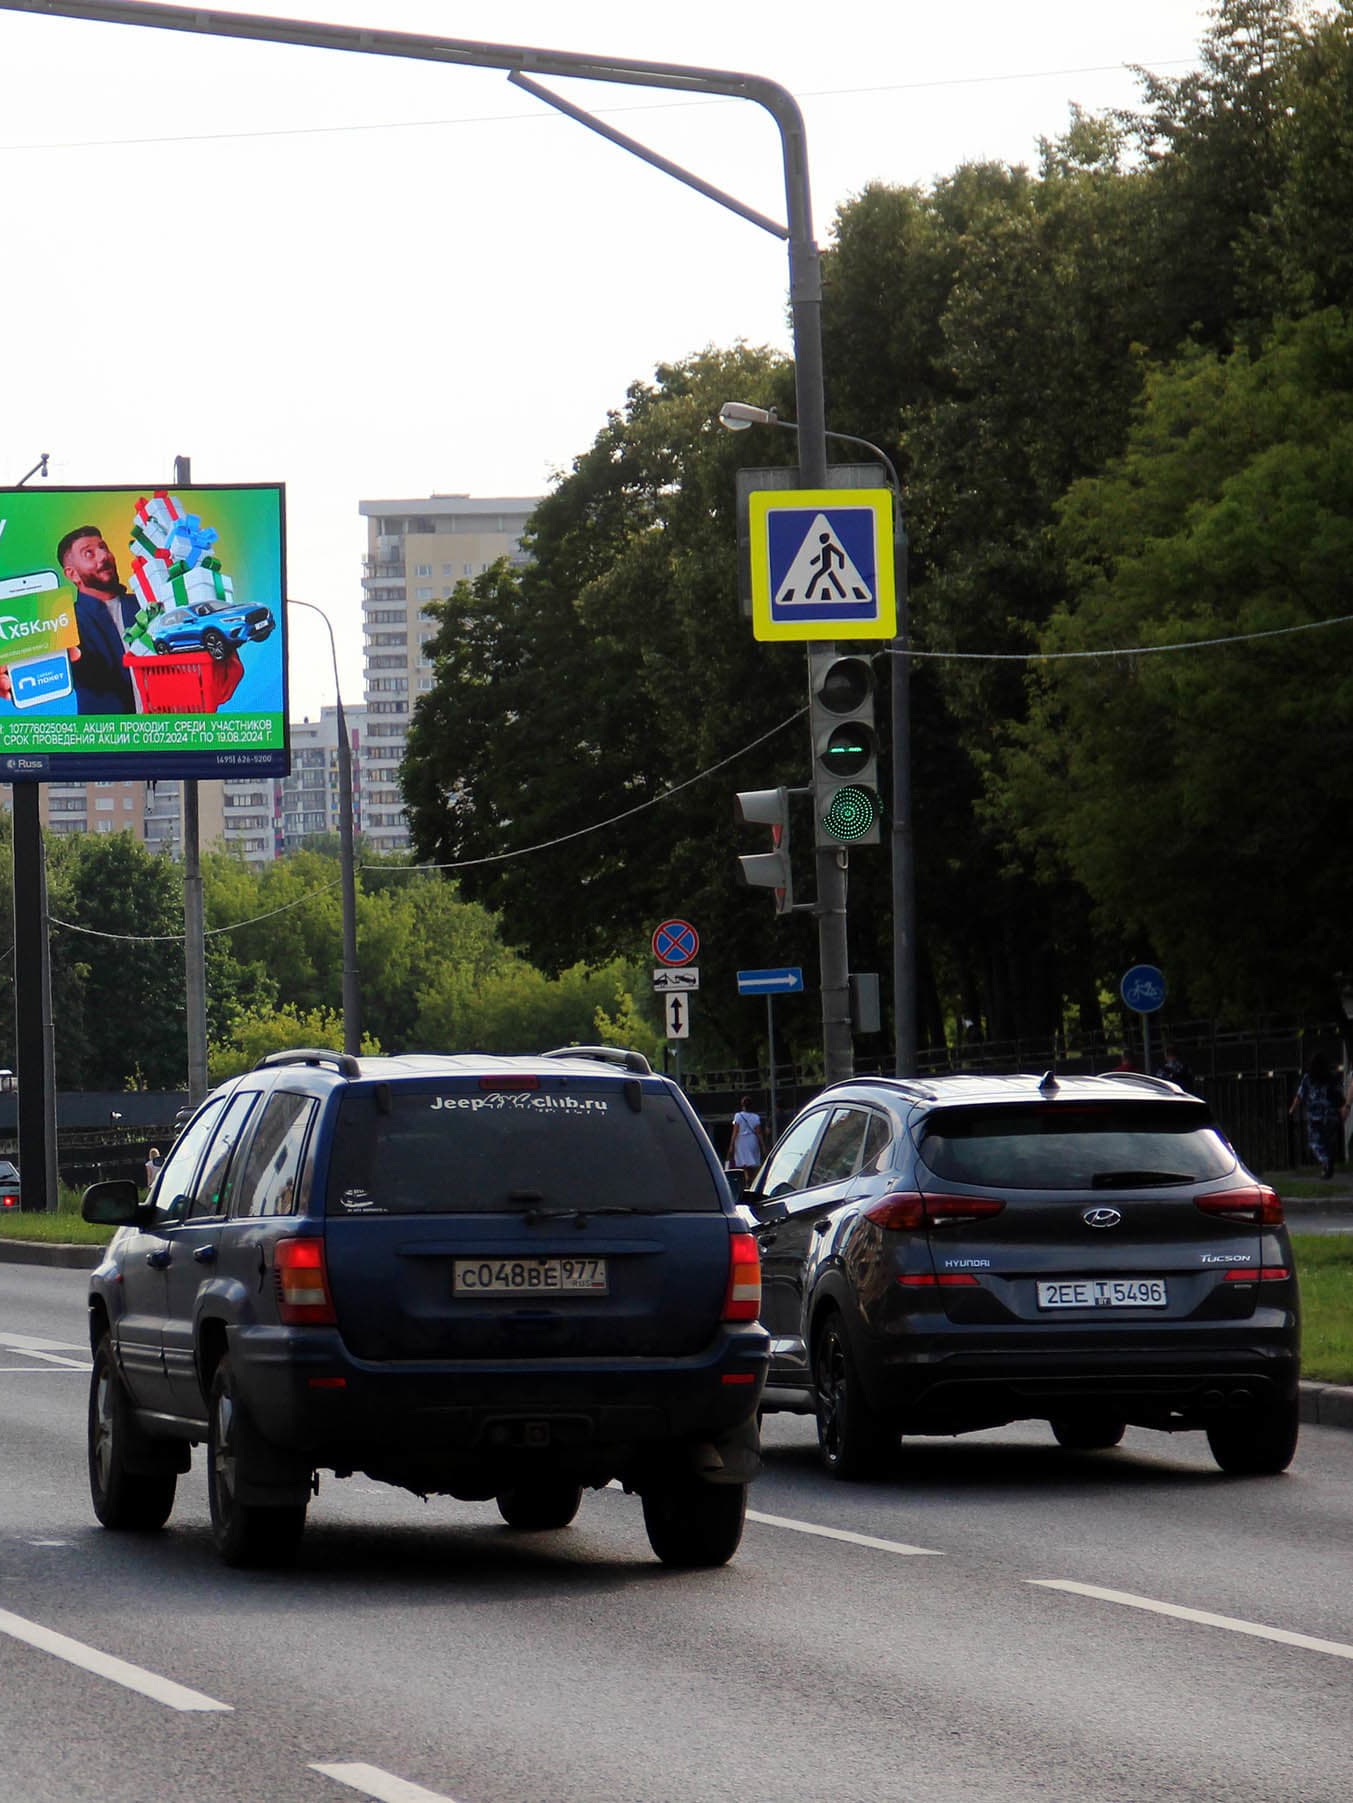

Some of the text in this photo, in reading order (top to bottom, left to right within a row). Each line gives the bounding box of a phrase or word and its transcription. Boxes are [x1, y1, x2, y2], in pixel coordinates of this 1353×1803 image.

[83, 722, 115, 734] АКЦИЯ
[119, 721, 170, 733] ПРОХОДИТ
[174, 721, 206, 732] СРЕДИ
[210, 719, 273, 731] УЧАСТНИКОВ
[3, 734, 29, 746] СРОК
[32, 733, 95, 746] ПРОВЕДЕНИЯ
[98, 733, 130, 745] АКЦИИ
[199, 732, 214, 743] ПО
[18, 759, 43, 769] Russ
[430, 1096, 485, 1111] Jeep
[562, 1261, 599, 1280] 977
[945, 1259, 991, 1268] HYUNDAI
[1046, 1285, 1086, 1304] 2EE
[1114, 1283, 1162, 1302] 5496
